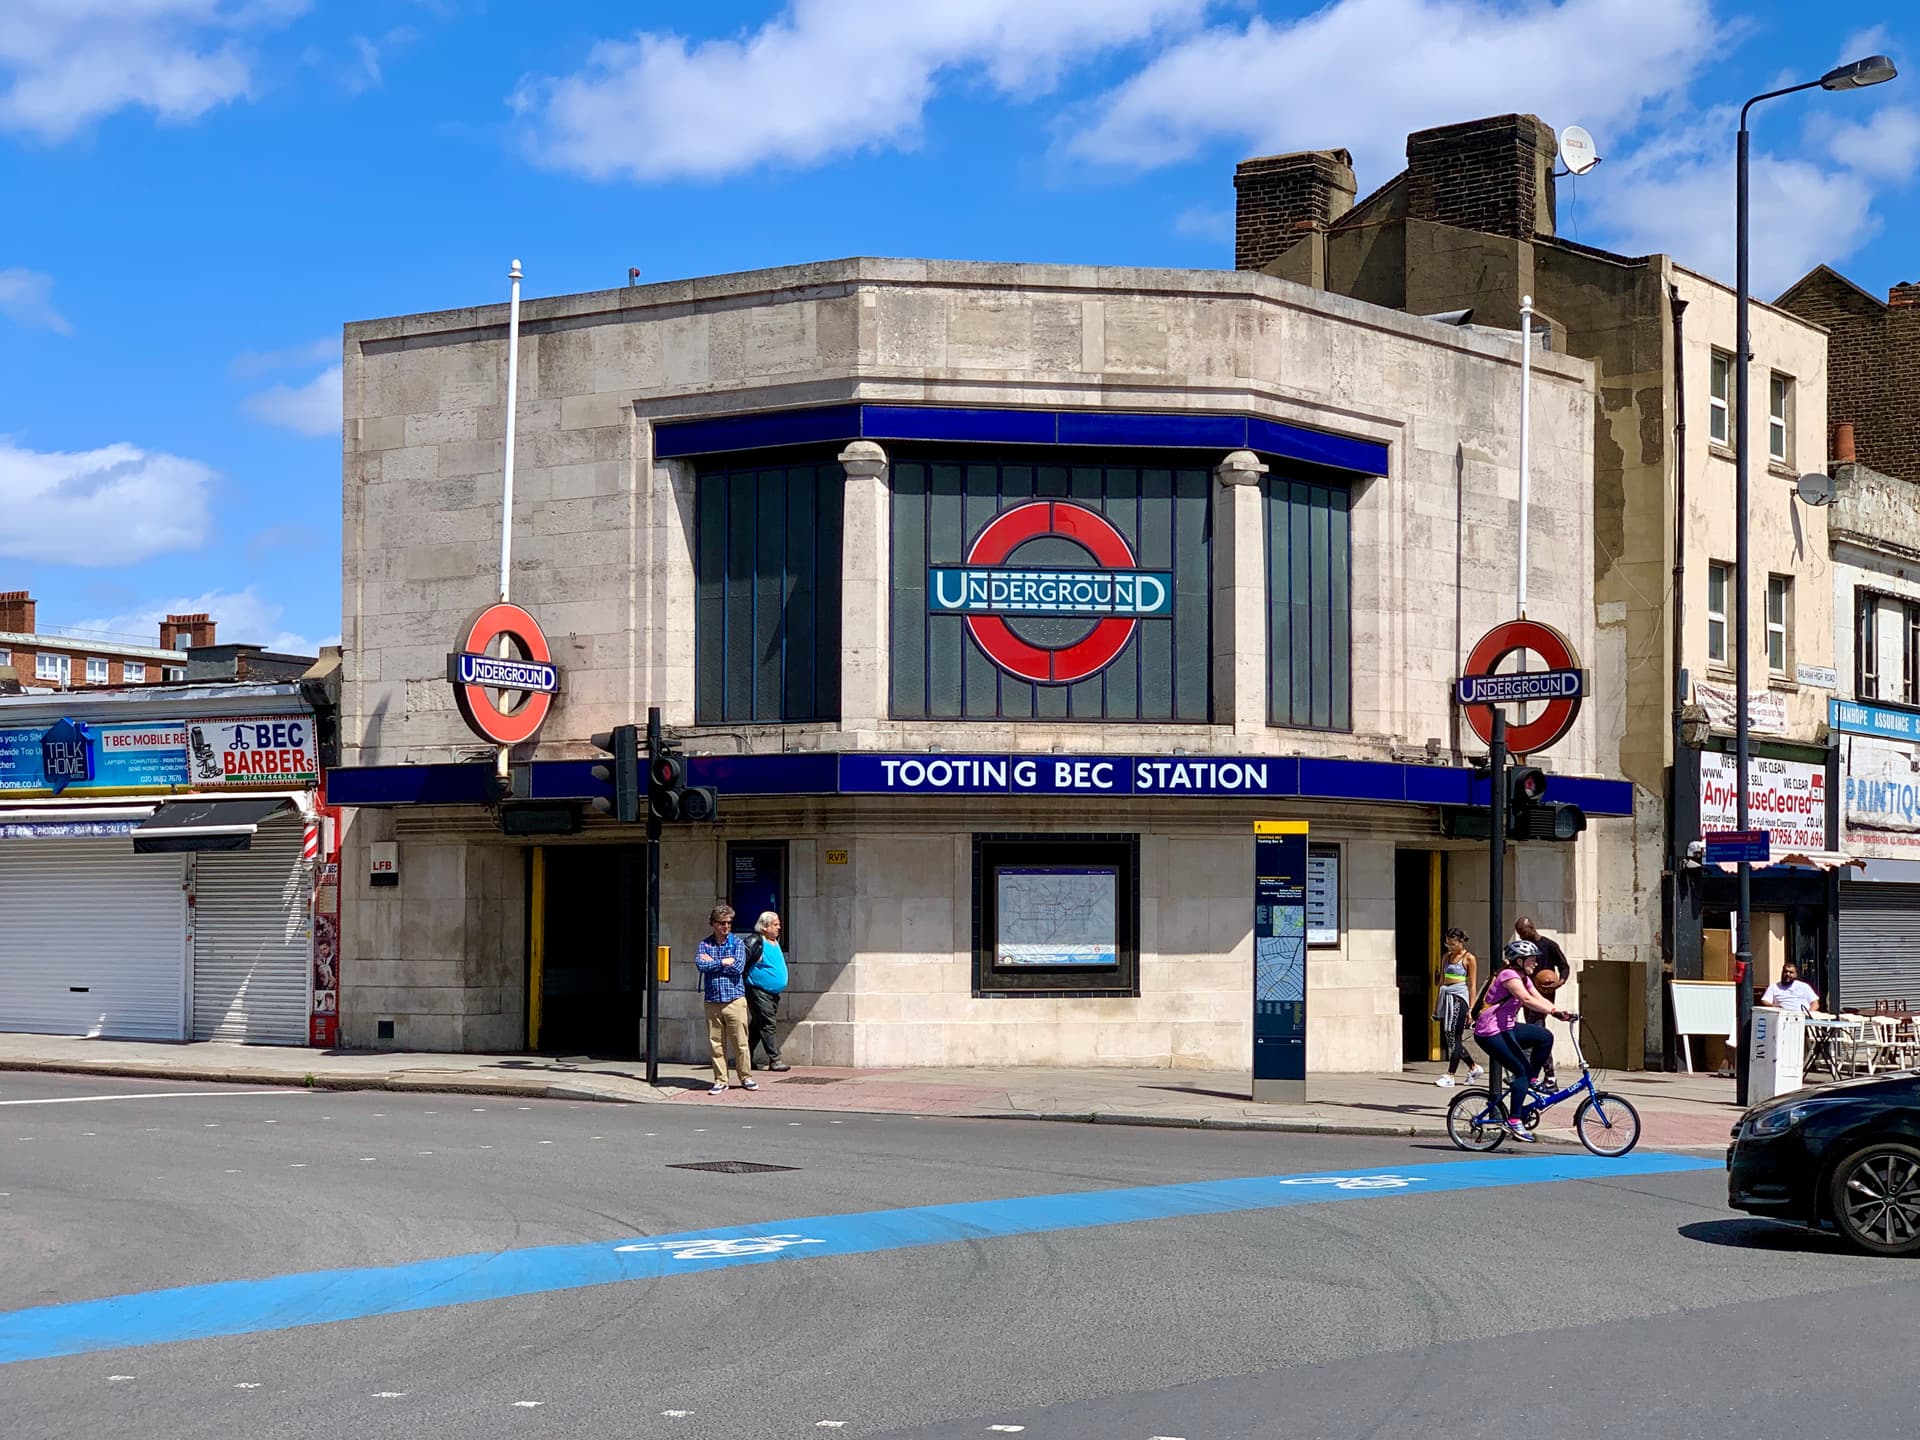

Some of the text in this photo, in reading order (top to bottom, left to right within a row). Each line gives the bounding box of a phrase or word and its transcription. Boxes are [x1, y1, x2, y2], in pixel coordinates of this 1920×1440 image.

[936, 571, 1166, 612] UNDERGROUND
[461, 656, 556, 690] UNDERGROUND
[1824, 672, 1835, 682] ROAD
[1460, 673, 1579, 702] UNDERGROUND
[1834, 704, 1868, 726] STANHOPE
[1874, 712, 1909, 733] ASSURANCE
[4, 735, 18, 744] you
[18, 734, 28, 742] Go
[104, 736, 110, 747] T
[112, 735, 132, 746] BEC
[134, 734, 171, 746] MOBILE
[256, 722, 304, 749] BEC
[21, 748, 34, 758] Top
[46, 741, 84, 758] TALK
[48, 758, 85, 775] HOME
[1720, 756, 1730, 768] WE
[1758, 762, 1786, 774] WE CLEAN
[881, 760, 1267, 789] TOOTING BEC STATION
[1751, 775, 1763, 786] SELL
[1784, 778, 1808, 790] WE CLEAR
[1704, 780, 1812, 814] AnyHuseCleared
[1702, 812, 1721, 823] Licensed
[1722, 814, 1736, 824] Waste
[1765, 818, 1776, 827] House
[1804, 814, 1823, 828] .co.uk
[107, 824, 120, 832] CALL
[1769, 828, 1823, 847] 07956 290 696
[828, 853, 846, 862] RVP
[373, 861, 392, 871] LFB
